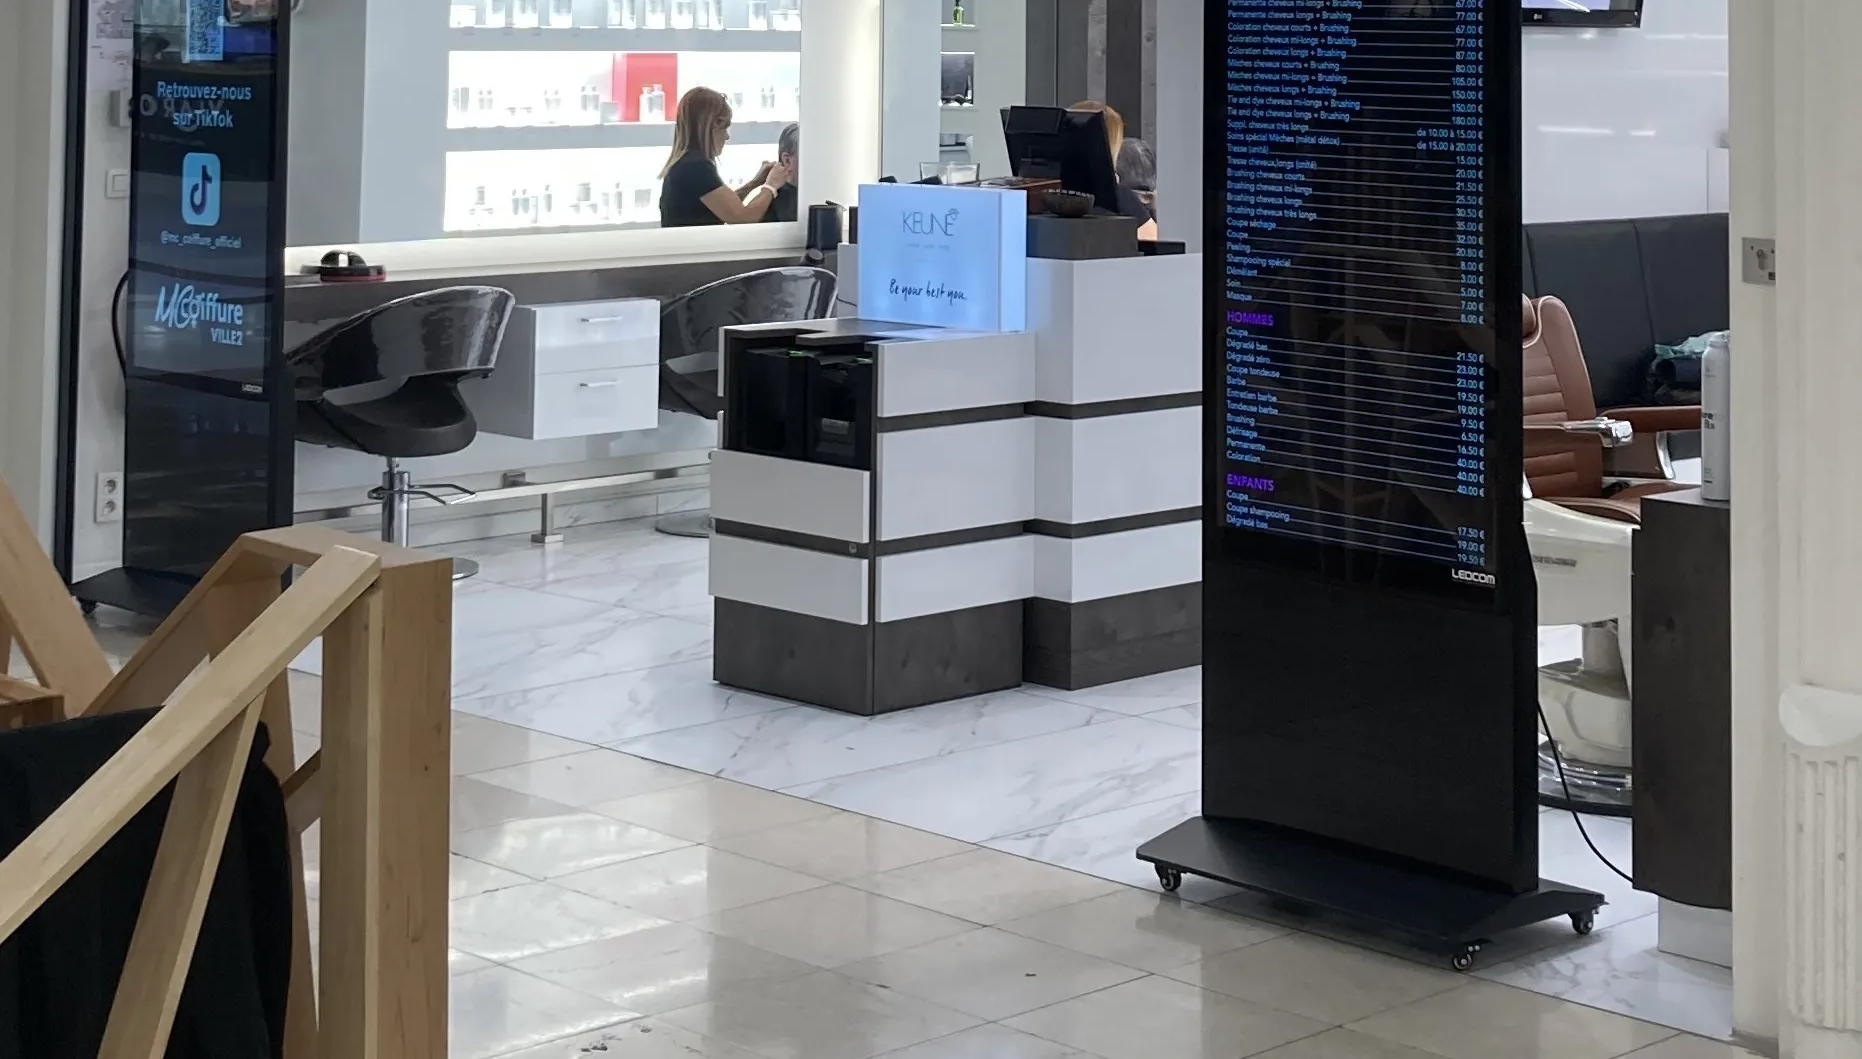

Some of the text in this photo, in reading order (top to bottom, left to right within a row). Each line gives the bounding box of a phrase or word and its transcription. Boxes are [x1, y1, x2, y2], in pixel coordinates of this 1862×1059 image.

[1332, 0, 1362, 9] Brushing
[1322, 11, 1351, 21] Brushing
[1228, 22, 1261, 30] Coloration
[1320, 23, 1349, 34] Brushing
[1228, 34, 1261, 42] Coloration
[1327, 36, 1356, 47] Brushing
[1228, 46, 1261, 54] Coloration
[1317, 48, 1346, 59] Brushing
[1310, 61, 1340, 71] Brushing
[1317, 73, 1347, 84] Brushing
[157, 81, 251, 101] Retrouvez-nous
[1307, 85, 1337, 96] Brushing
[1228, 95, 1237, 103] Tie
[1331, 99, 1360, 110] Brushing
[173, 110, 234, 128] sur TikTok
[1228, 107, 1237, 115] Tie
[1320, 111, 1349, 122] Brushing
[1291, 122, 1309, 133] longs
[1227, 168, 1254, 179] Brushing
[1227, 180, 1254, 192] Brushing
[1227, 192, 1254, 204] Brushing
[1227, 205, 1254, 216] Brushing
[1299, 210, 1317, 221] longs
[903, 209, 957, 236] KEUNE
[1227, 217, 1248, 227] Coupe
[1227, 229, 1248, 240] Coupe
[889, 278, 899, 295] Be
[901, 286, 923, 302] your
[926, 280, 945, 298] best
[1227, 311, 1274, 326] HOMMES
[211, 328, 243, 346] VILLE2
[1226, 326, 1248, 337] Coupe
[1227, 364, 1248, 375] Coupe
[1227, 413, 1255, 426] Brushing
[1227, 474, 1274, 491] ENFANTS
[1452, 568, 1496, 585] LEDCOM
